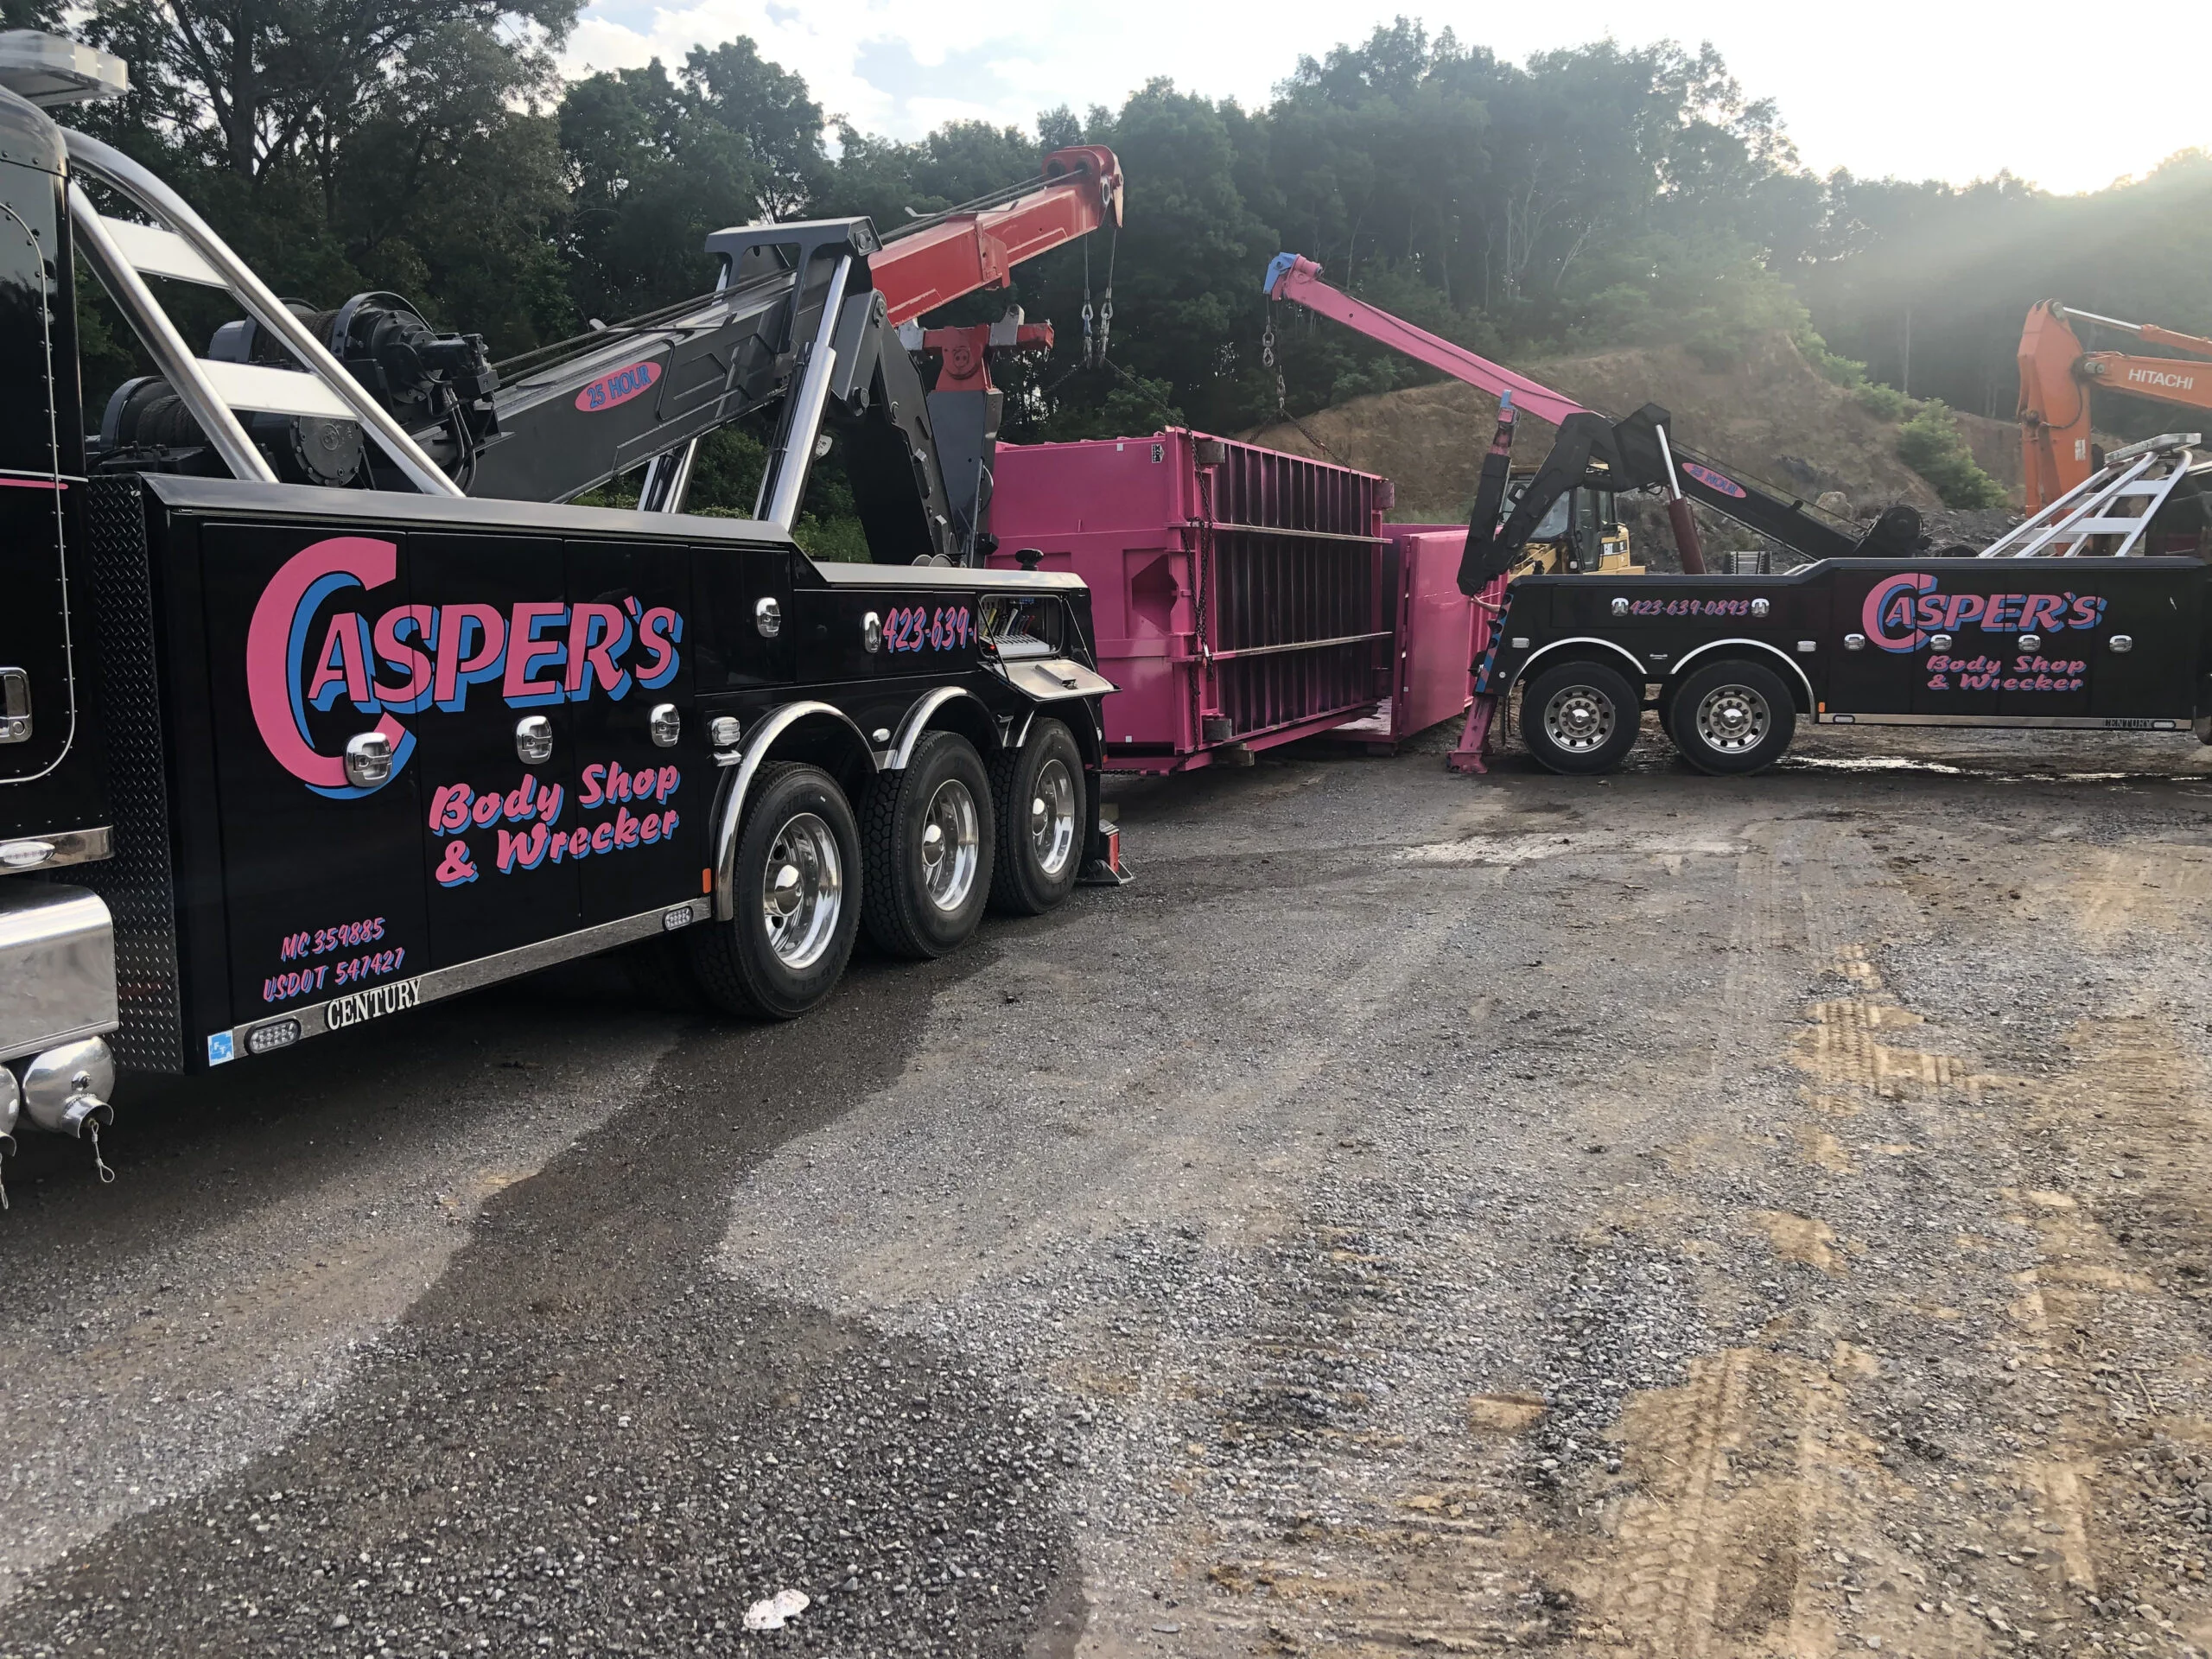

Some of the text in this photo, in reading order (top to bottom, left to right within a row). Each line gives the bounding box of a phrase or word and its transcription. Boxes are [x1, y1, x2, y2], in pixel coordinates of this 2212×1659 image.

[587, 365, 652, 409] 25 HOUR
[2128, 368, 2194, 391] HITACHI
[883, 607, 977, 653] 423-639-
[1630, 600, 1750, 616] 423-639-0893
[1862, 573, 2107, 653] CASPER'S
[247, 537, 683, 799] CASPER'S
[1926, 655, 2087, 676] Body Shop
[1927, 673, 2083, 690] & Wrecker
[429, 761, 680, 836] Body Shop
[435, 807, 679, 887] & Wrecker
[281, 917, 385, 962] MC 359885
[263, 947, 405, 1002] USDOT 547427
[327, 978, 422, 1030] CENTURY
